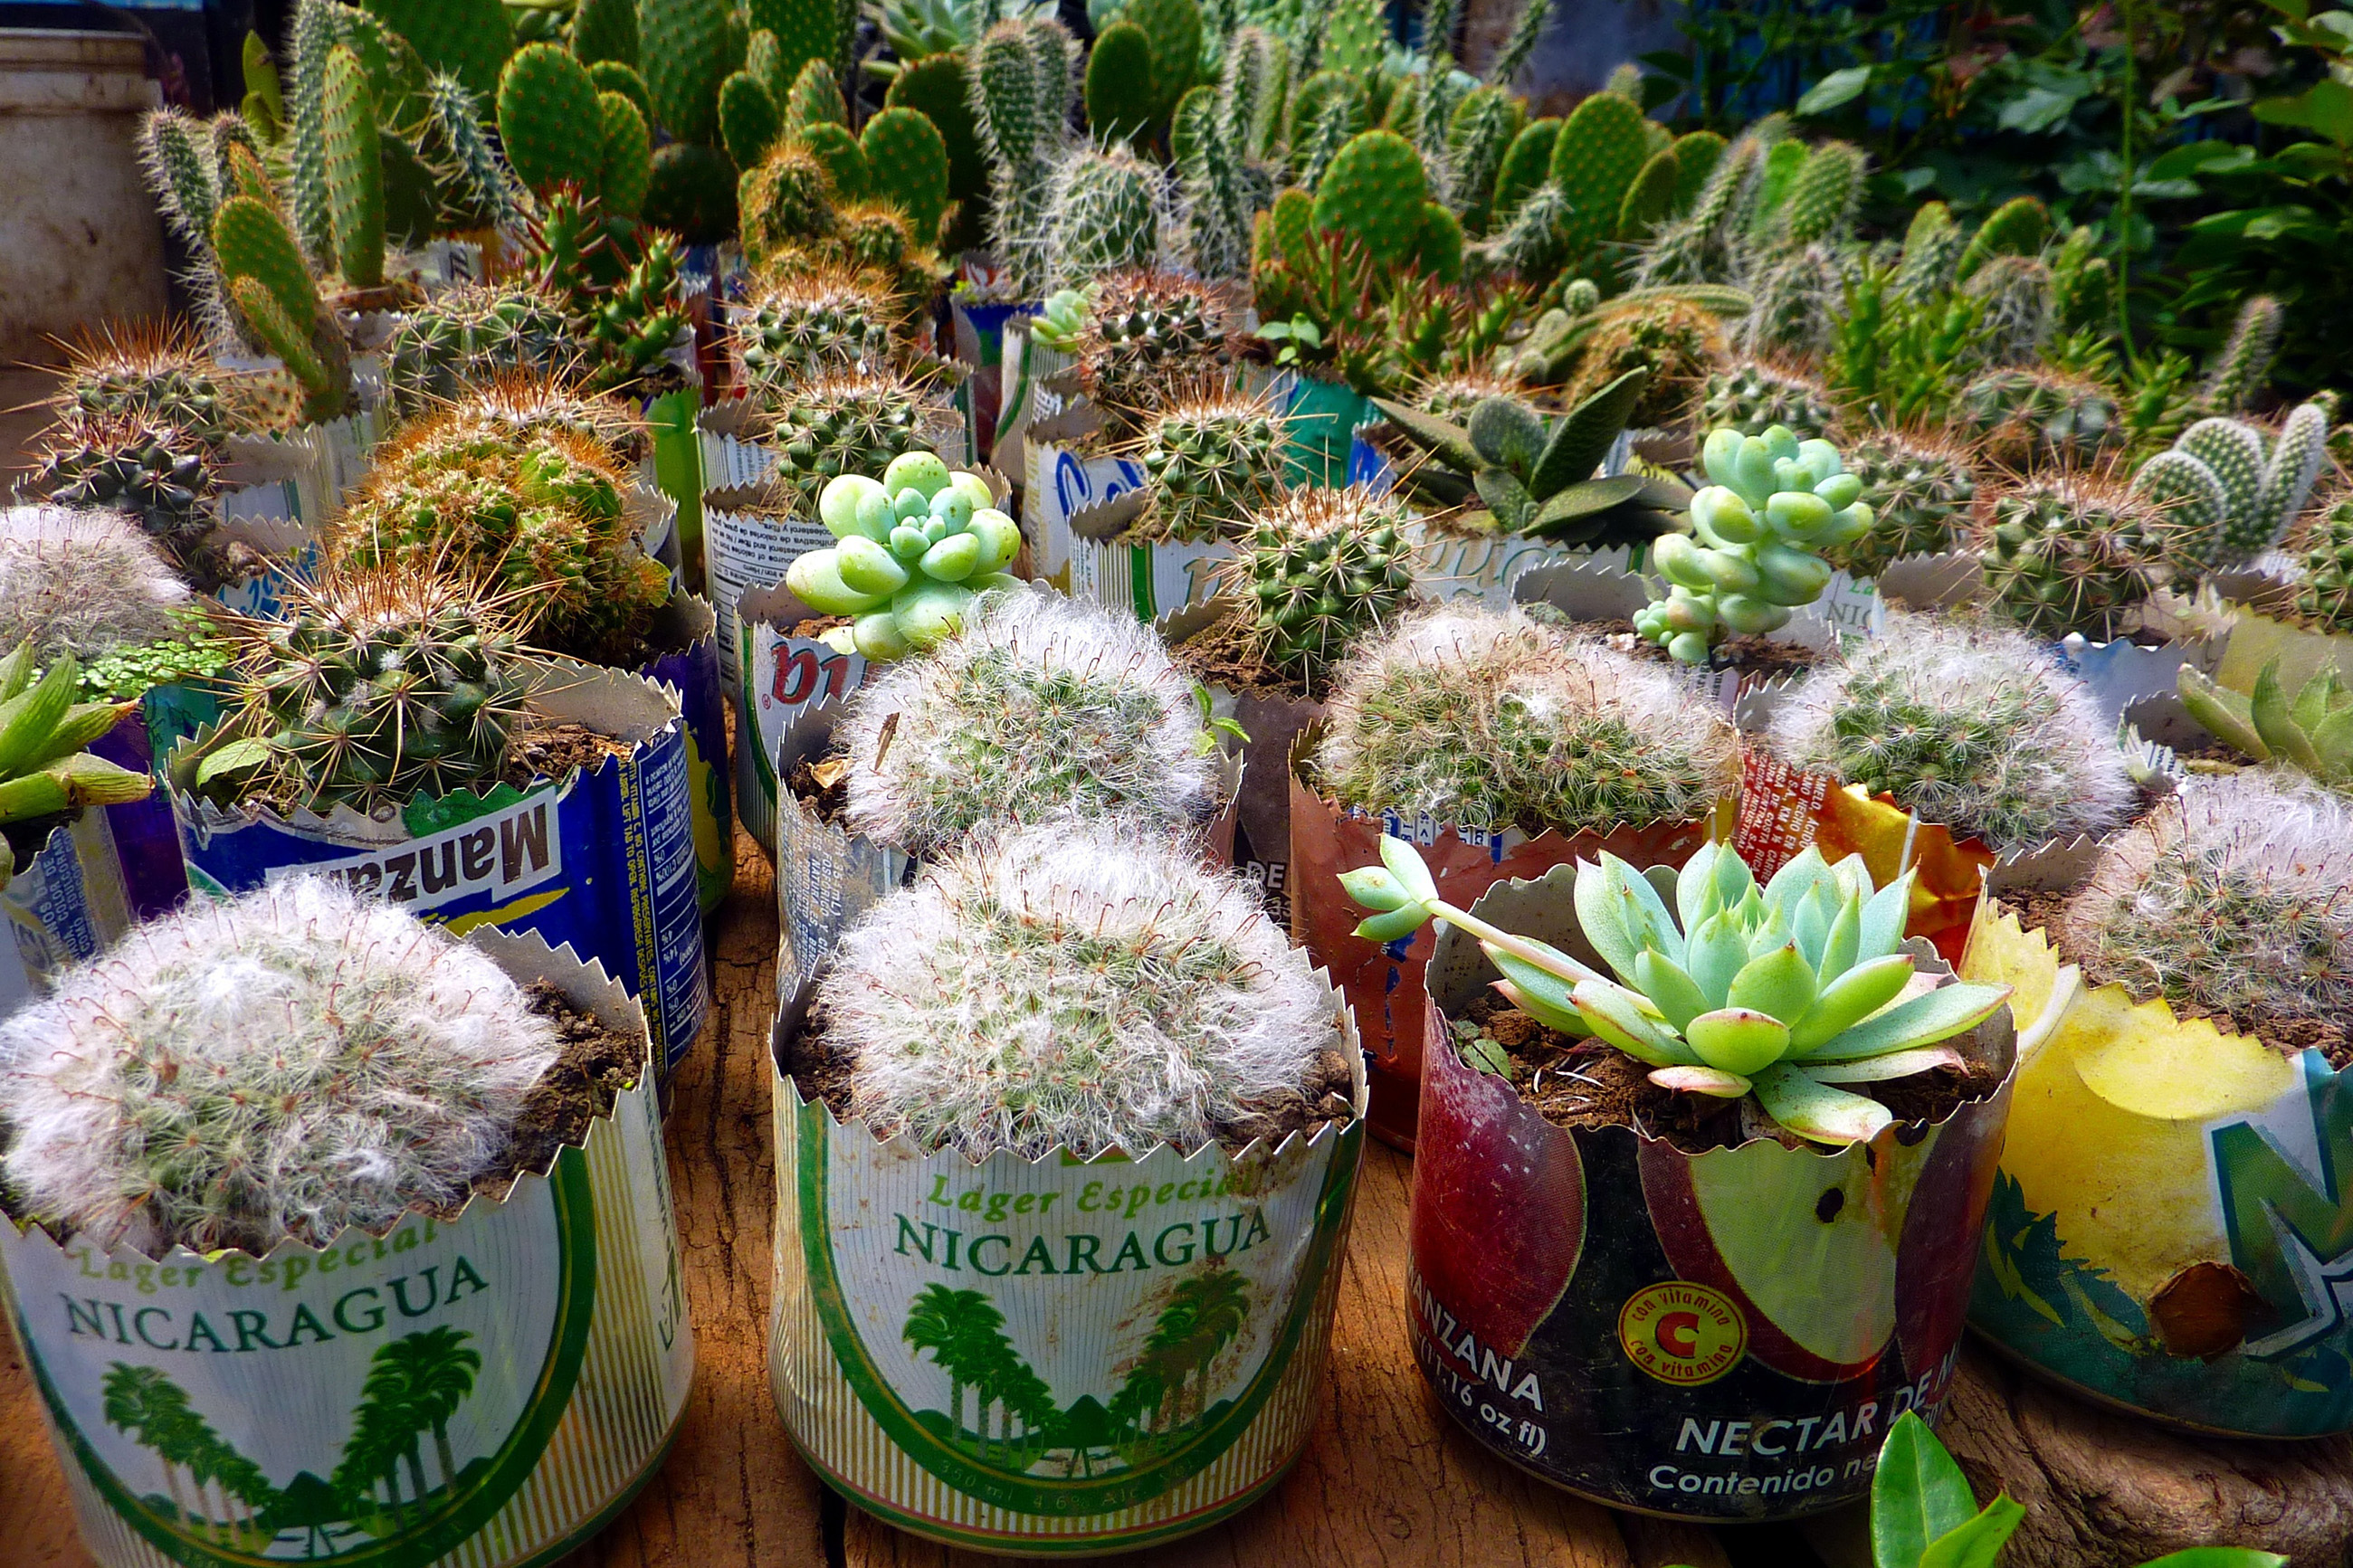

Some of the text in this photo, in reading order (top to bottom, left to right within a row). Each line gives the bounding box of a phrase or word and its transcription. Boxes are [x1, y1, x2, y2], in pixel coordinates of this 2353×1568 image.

[1752, 786, 1771, 829] CENTRAL
[1809, 774, 1828, 812] AMELO,
[1759, 812, 1776, 844] COSTA
[1789, 797, 1809, 832] HECHO
[1783, 834, 1796, 851] EN
[43, 857, 58, 878] DE
[52, 831, 80, 910] EDULCORANT
[49, 880, 70, 922] COLOR
[928, 1174, 1062, 1222] Lager
[893, 1204, 1272, 1277] NICARAGUA
[60, 1256, 490, 1353] NICARAGUA
[1632, 1288, 1730, 1326] con vitamina
[1409, 1256, 1543, 1412] ANZANA
[1654, 1311, 1700, 1359] C
[1630, 1340, 1734, 1378] con vitamina
[1480, 1402, 1511, 1435] oz
[1674, 1402, 1879, 1456] NECTAR
[1887, 1367, 1934, 1426] DE
[1649, 1451, 1880, 1496] Contenido ne
